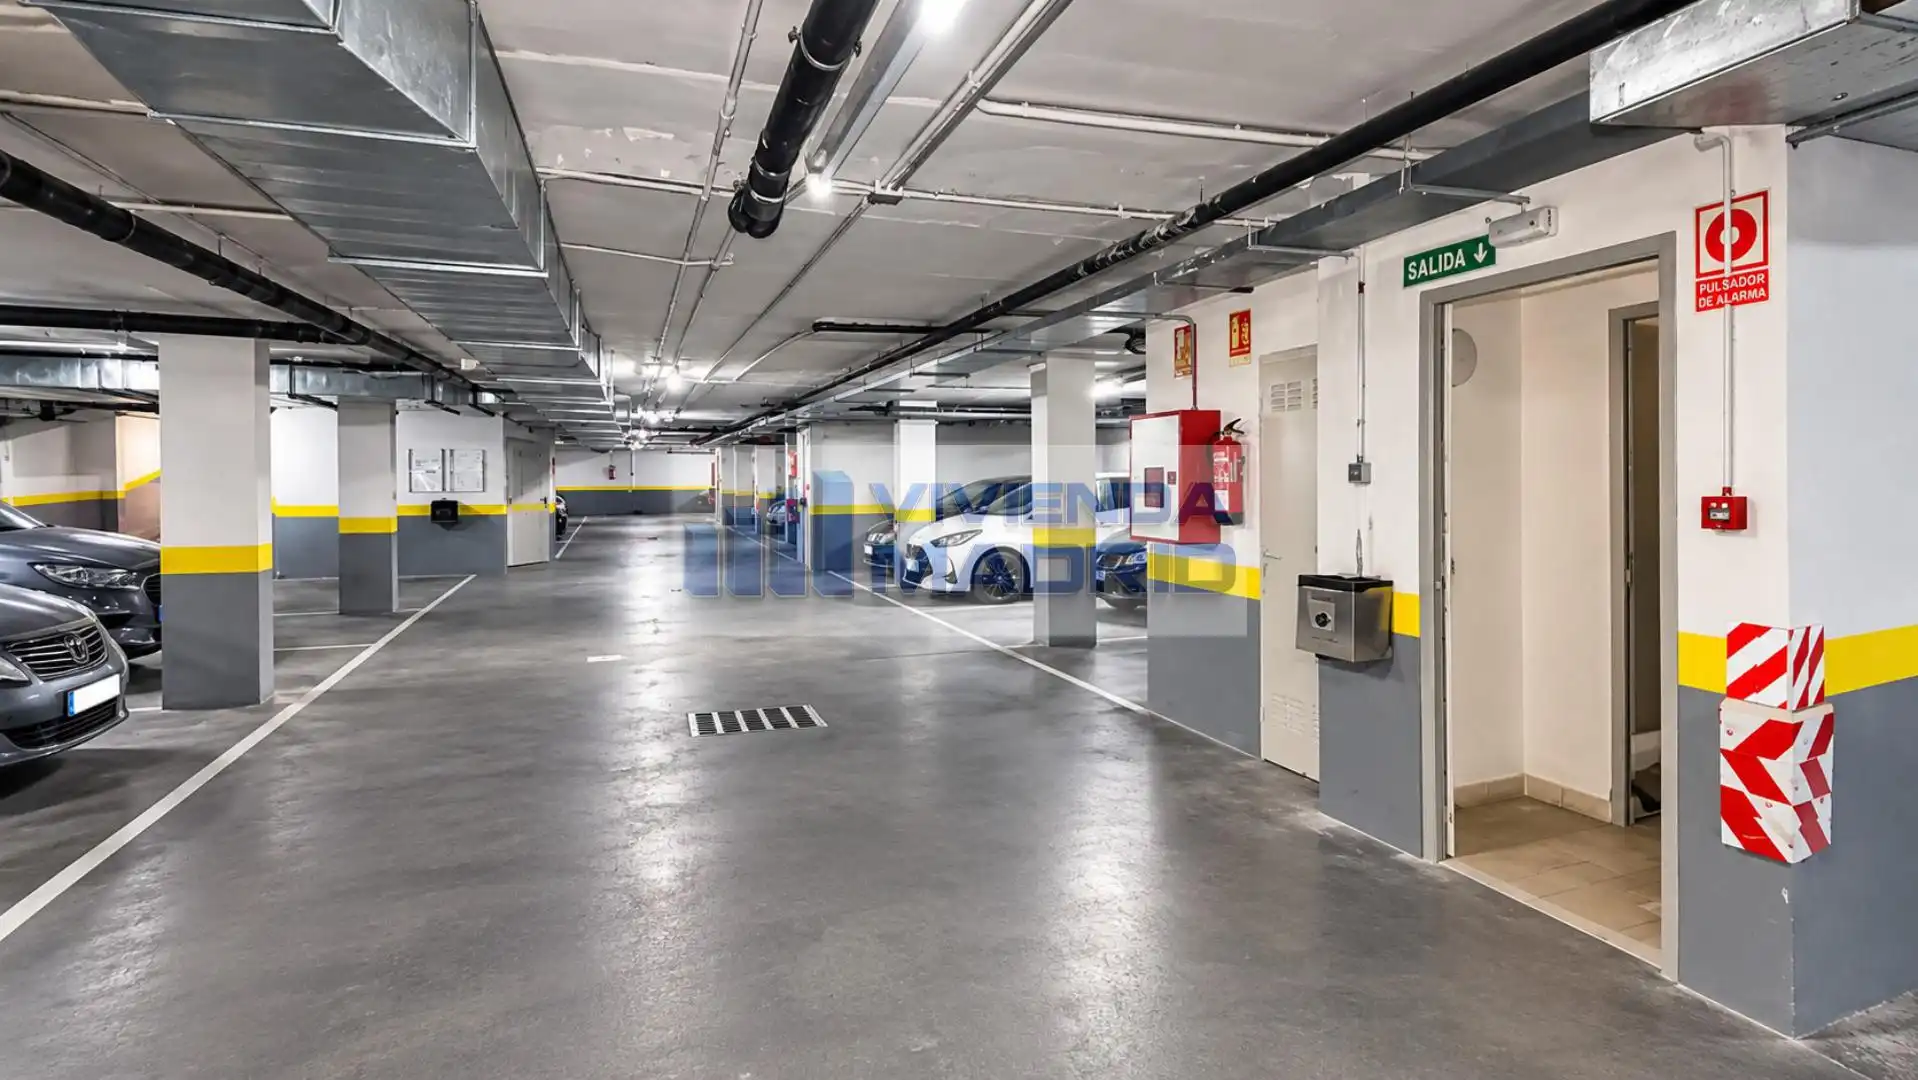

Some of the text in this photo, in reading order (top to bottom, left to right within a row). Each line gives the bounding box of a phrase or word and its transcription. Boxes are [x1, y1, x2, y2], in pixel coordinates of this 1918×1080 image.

[1408, 248, 1466, 280] SALIDA
[1699, 272, 1765, 294] PULSADOR
[1698, 287, 1766, 308] DE ALARMA
